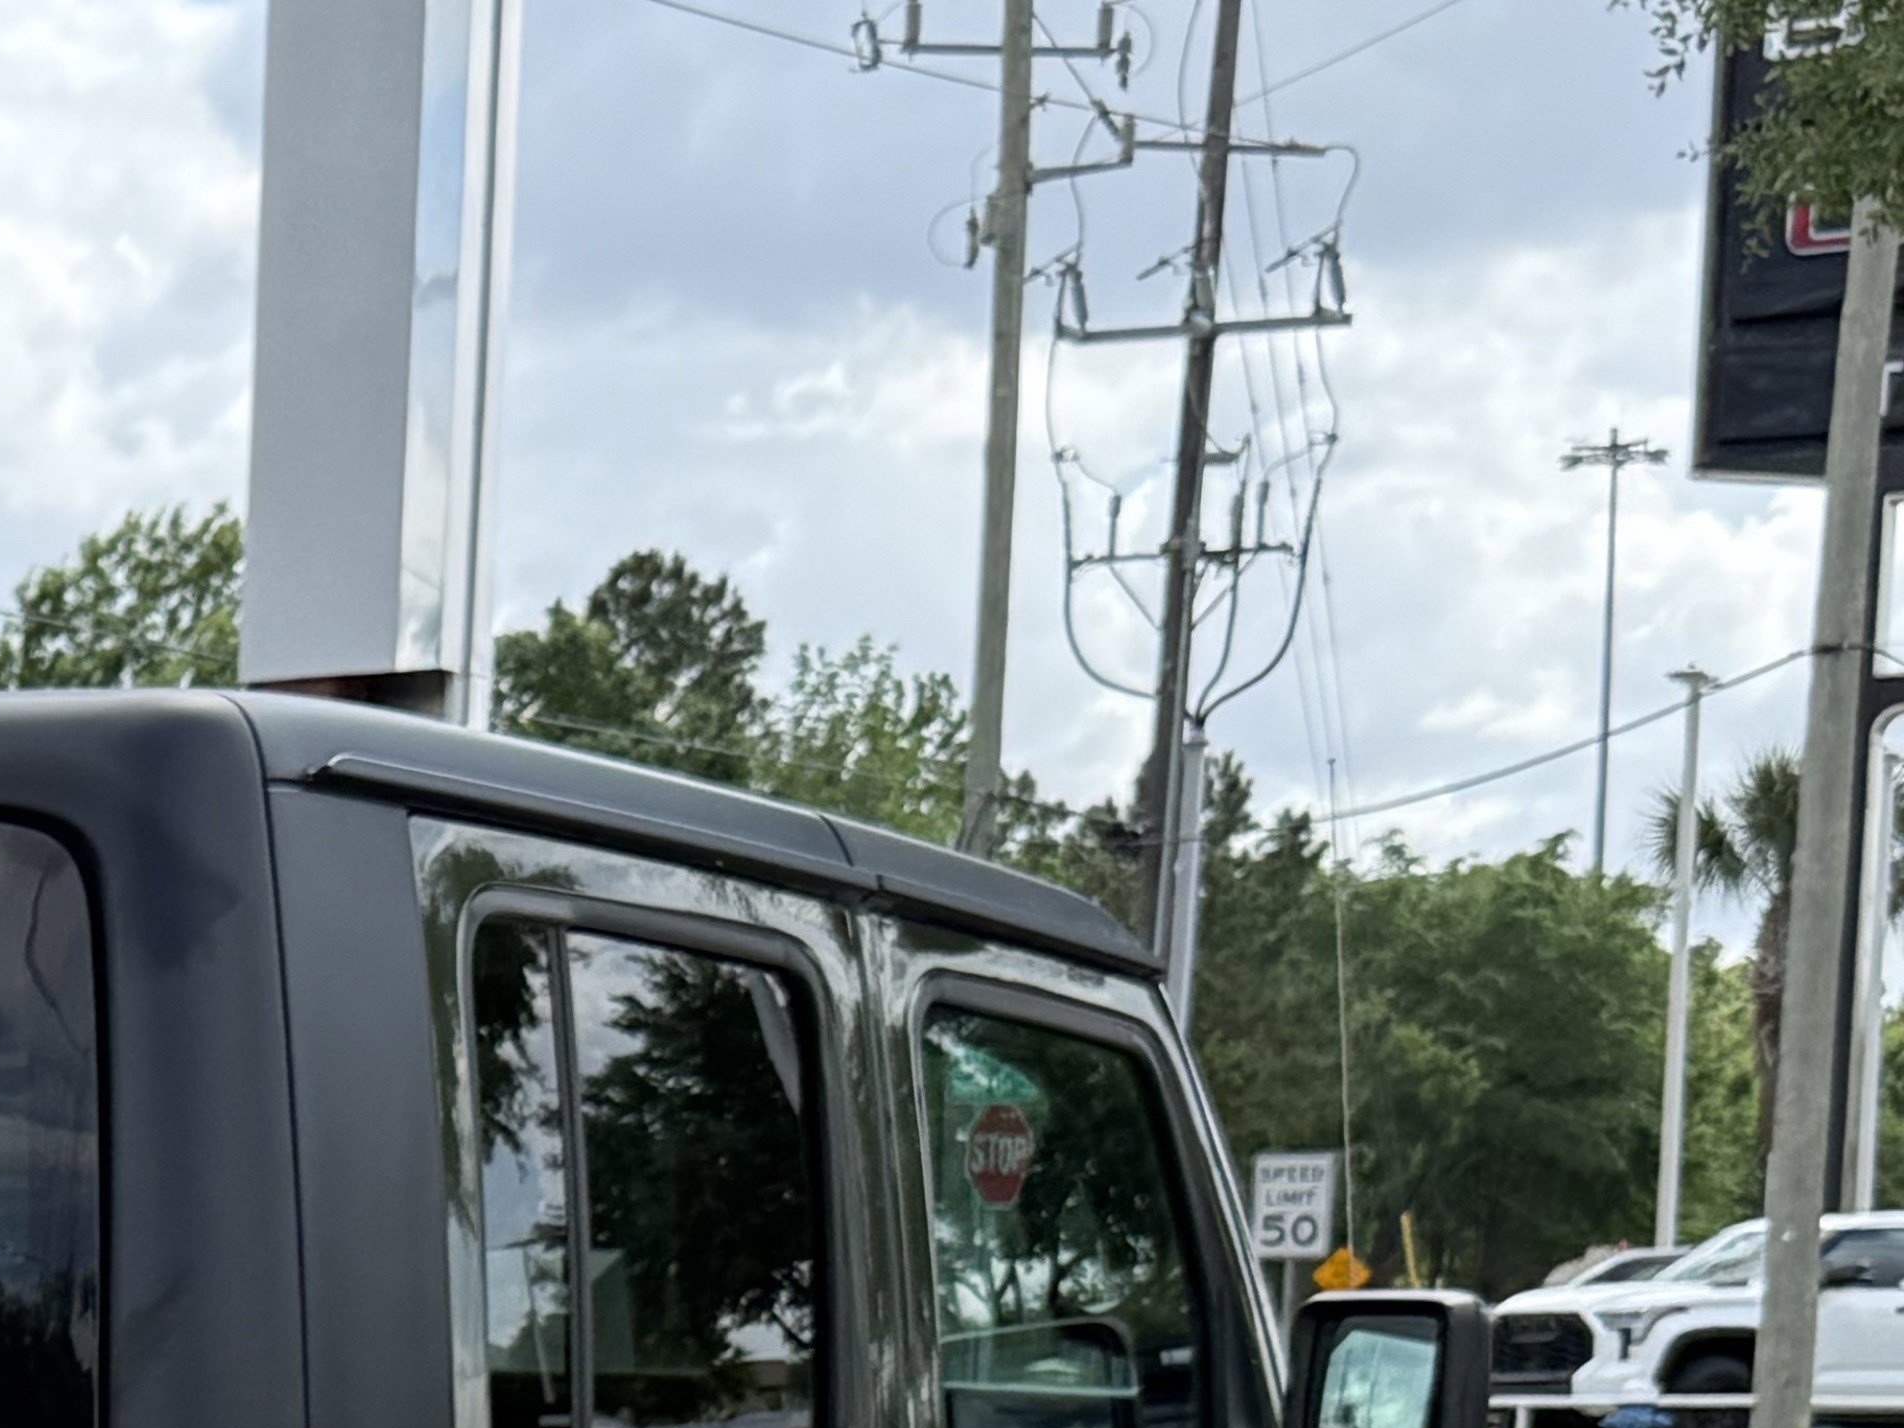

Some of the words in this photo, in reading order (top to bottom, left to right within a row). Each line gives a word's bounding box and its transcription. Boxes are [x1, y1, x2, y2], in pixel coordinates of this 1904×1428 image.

[970, 1133, 1027, 1175] STOP
[1260, 1166, 1325, 1184] SPEED
[1265, 1187, 1318, 1207] LIMIT
[1260, 1214, 1318, 1247] 50
